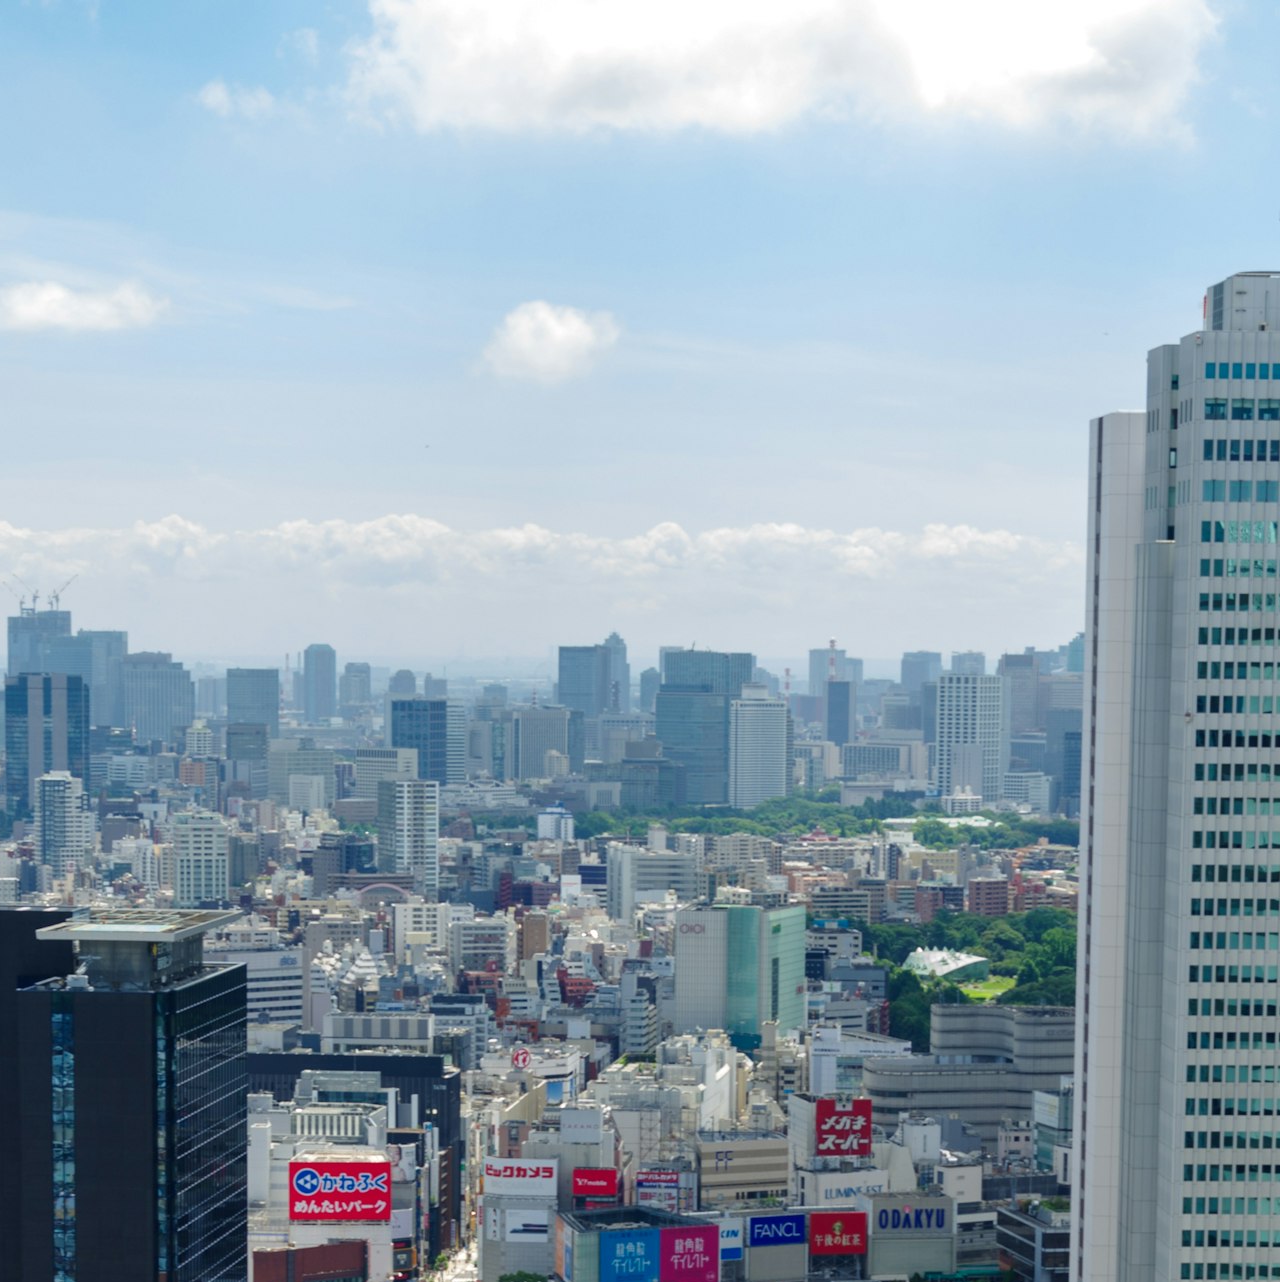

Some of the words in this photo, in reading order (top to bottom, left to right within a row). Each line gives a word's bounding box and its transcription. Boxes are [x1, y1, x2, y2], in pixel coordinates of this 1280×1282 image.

[821, 1115, 867, 1131] メガネ
[818, 1133, 869, 1150] スーパー
[485, 1163, 554, 1178] ビックカメラ
[321, 1172, 388, 1193] かねふく
[293, 1200, 387, 1214] めんたいパーク
[878, 1208, 945, 1229] ODAKYU
[754, 1222, 801, 1239] FANCL
[815, 1233, 862, 1247] 午後の紅茶
